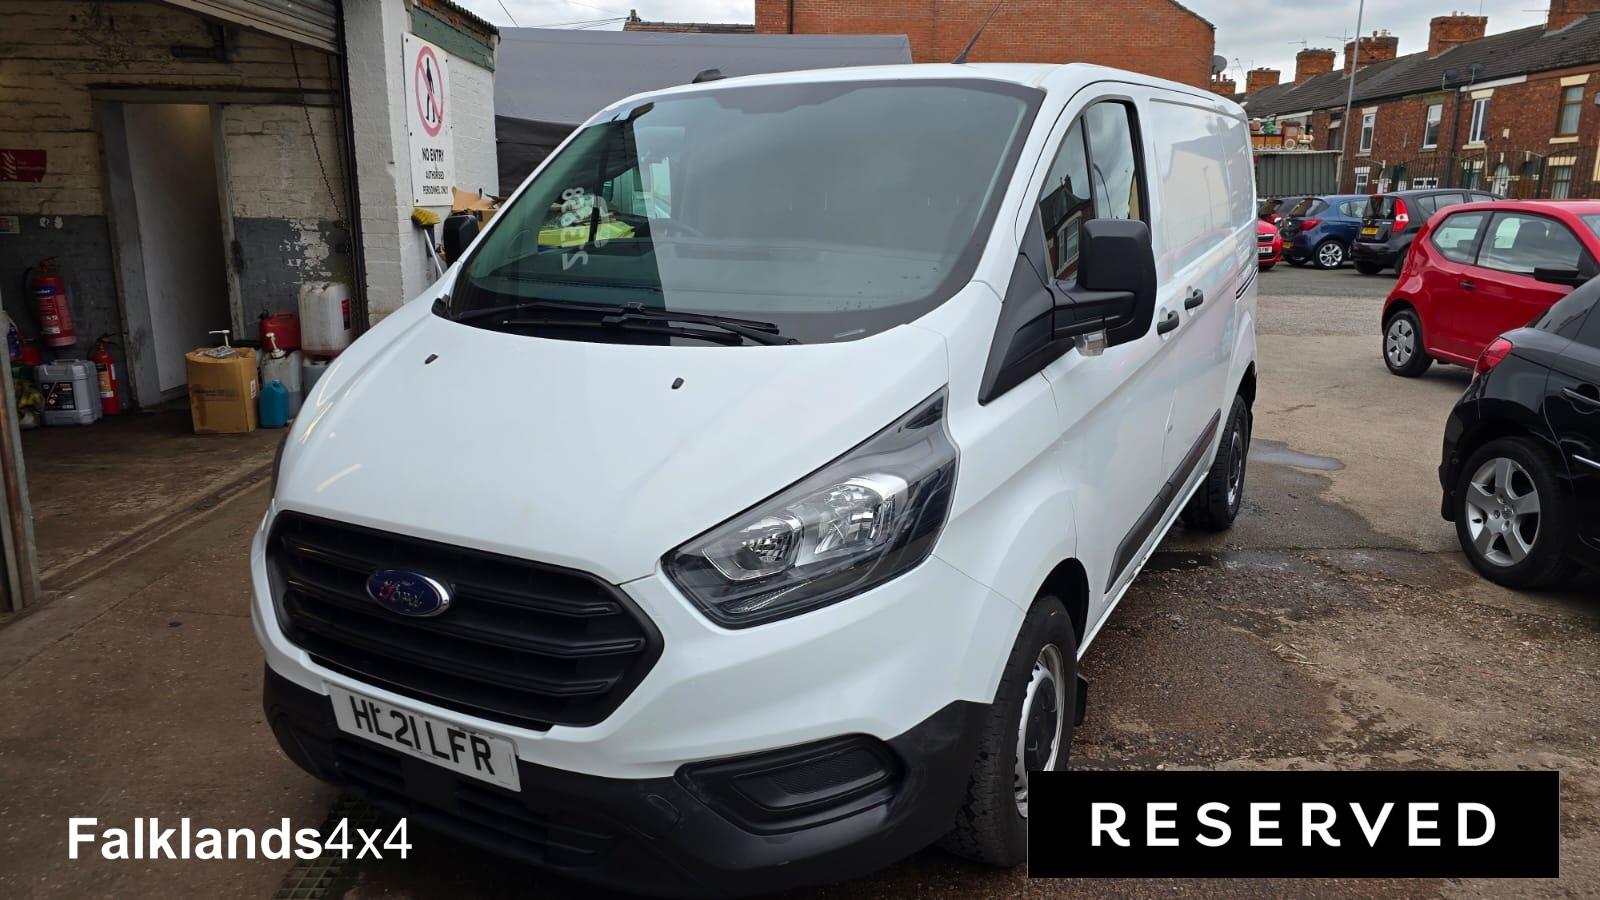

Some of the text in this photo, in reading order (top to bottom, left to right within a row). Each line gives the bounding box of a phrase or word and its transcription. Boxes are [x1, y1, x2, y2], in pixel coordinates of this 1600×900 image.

[421, 147, 444, 162] NO ENTRY
[425, 171, 444, 179] AUTHORISED
[423, 185, 441, 194] PERSONNEL
[349, 695, 496, 775] HL21 LFR
